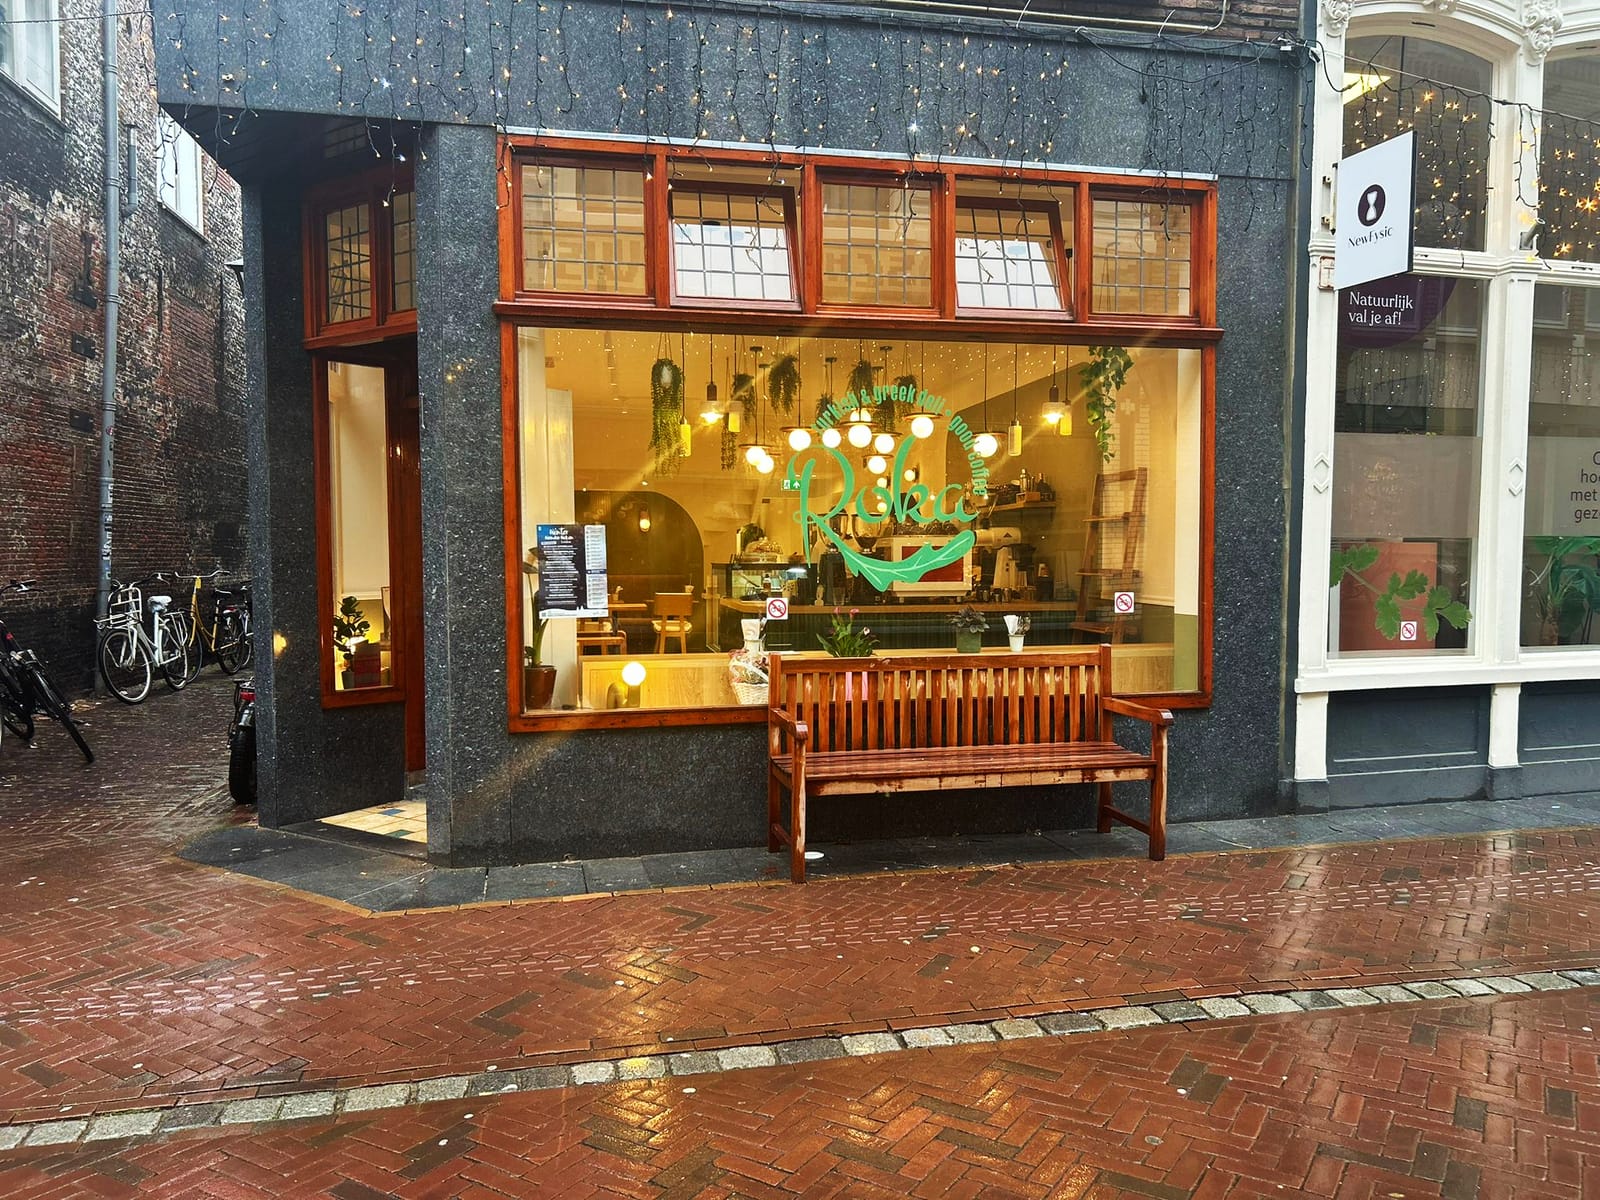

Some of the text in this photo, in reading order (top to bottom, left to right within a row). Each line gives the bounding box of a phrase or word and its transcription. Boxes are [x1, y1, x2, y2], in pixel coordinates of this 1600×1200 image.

[1349, 291, 1414, 312] Natuurlijk
[1349, 309, 1403, 327] val je af!
[860, 388, 872, 405] &
[873, 384, 916, 405] greek
[917, 389, 946, 415] deli
[947, 415, 979, 451] good
[967, 451, 990, 496] coffee
[787, 434, 981, 569] Roka
[1570, 489, 1598, 502] met
[1574, 508, 1600, 523] gez
